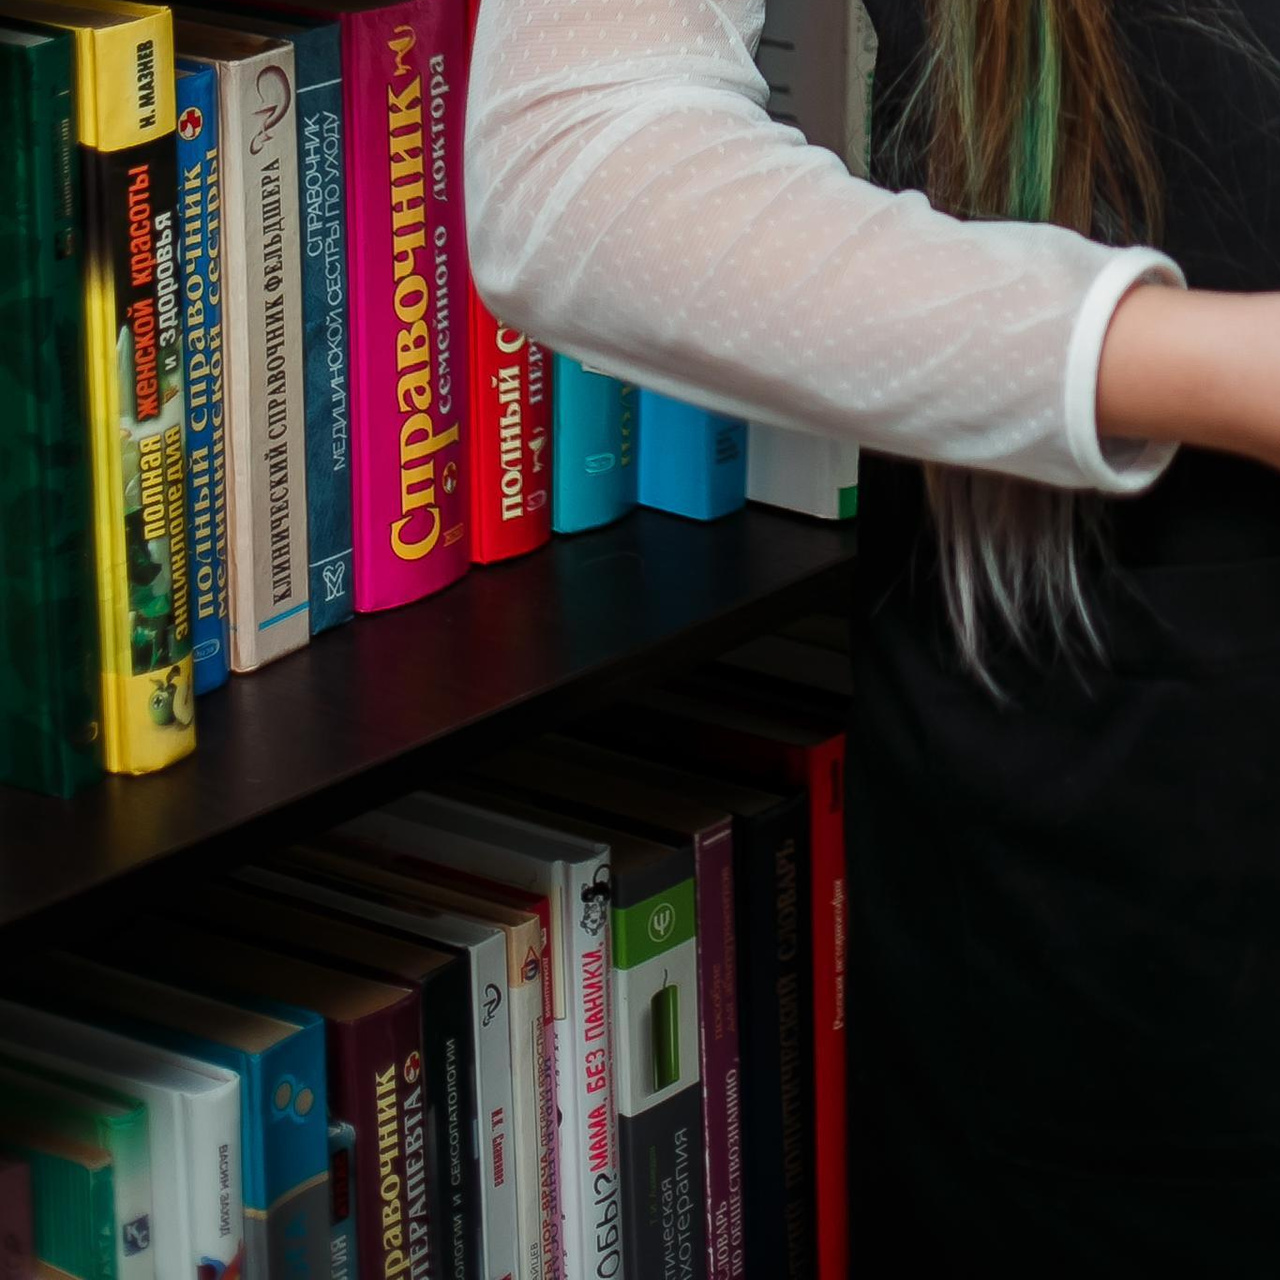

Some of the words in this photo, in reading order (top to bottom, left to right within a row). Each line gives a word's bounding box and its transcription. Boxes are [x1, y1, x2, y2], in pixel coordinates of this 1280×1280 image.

[136, 39, 156, 108] МАЗНЕВ
[139, 108, 156, 130] Н.
[303, 112, 324, 258] СПРАВОЧНИК
[322, 110, 340, 183] УХОДУ
[260, 157, 286, 291] ФЕЛЬДШЕРА
[323, 183, 340, 218] ПО
[324, 219, 343, 307] СЕСТРЫ
[265, 291, 289, 439] СПРАВОЧНИК
[387, 74, 459, 561] Справочник
[430, 225, 452, 416] семейного
[326, 308, 347, 472] МЕДИЦИНСКОЙ
[264, 440, 292, 601] КЛИНИЧЕСКИЙ
[581, 941, 607, 1043] ПАНИКИ,
[446, 1037, 462, 1186] СЕКСОПАТОЛОГИИ
[585, 1048, 607, 1094] БЕЗ
[585, 1096, 611, 1173] МАМА,
[539, 1152, 553, 1261] ЛОР-ВРАЧА
[731, 1247, 744, 1277] ПО
